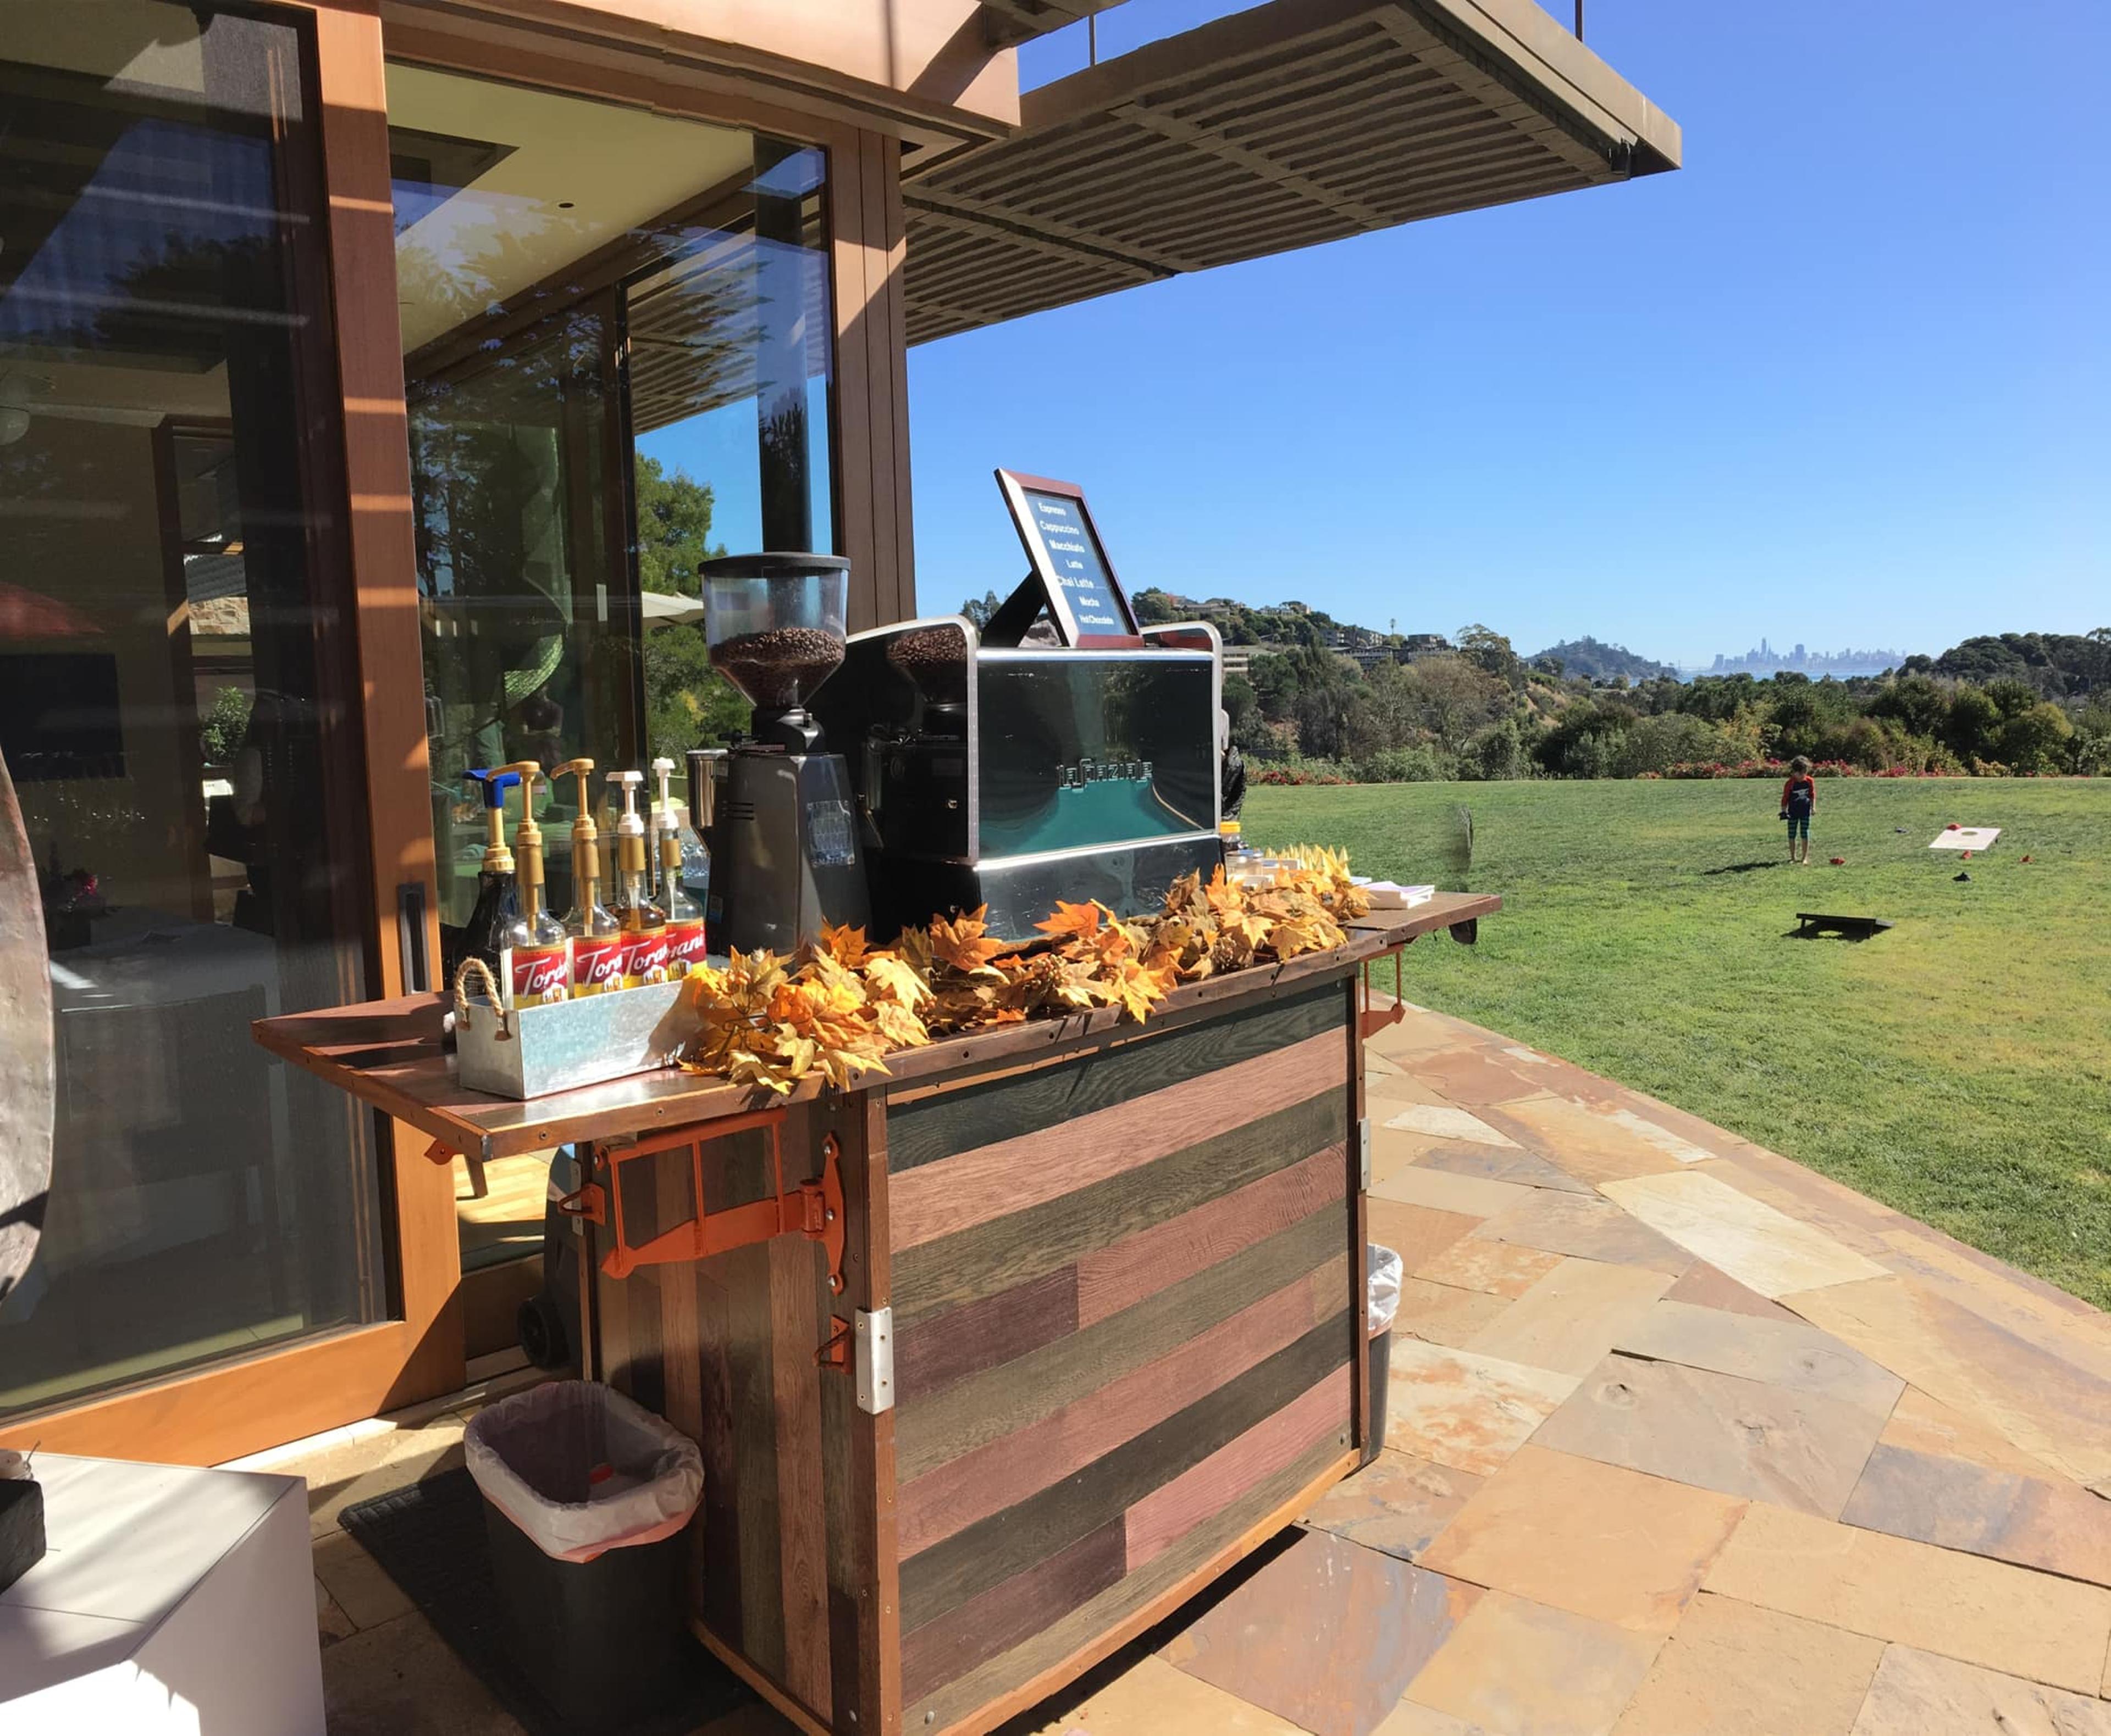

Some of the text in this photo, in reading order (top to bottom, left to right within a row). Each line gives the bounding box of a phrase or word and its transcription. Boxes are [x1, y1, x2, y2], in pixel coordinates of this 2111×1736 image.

[1040, 521, 1080, 535] Cappuccino
[1049, 539, 1085, 552] Macchiato
[1066, 559, 1084, 569] Latte
[1073, 577, 1094, 589] Latte
[1079, 596, 1100, 607] Mocha
